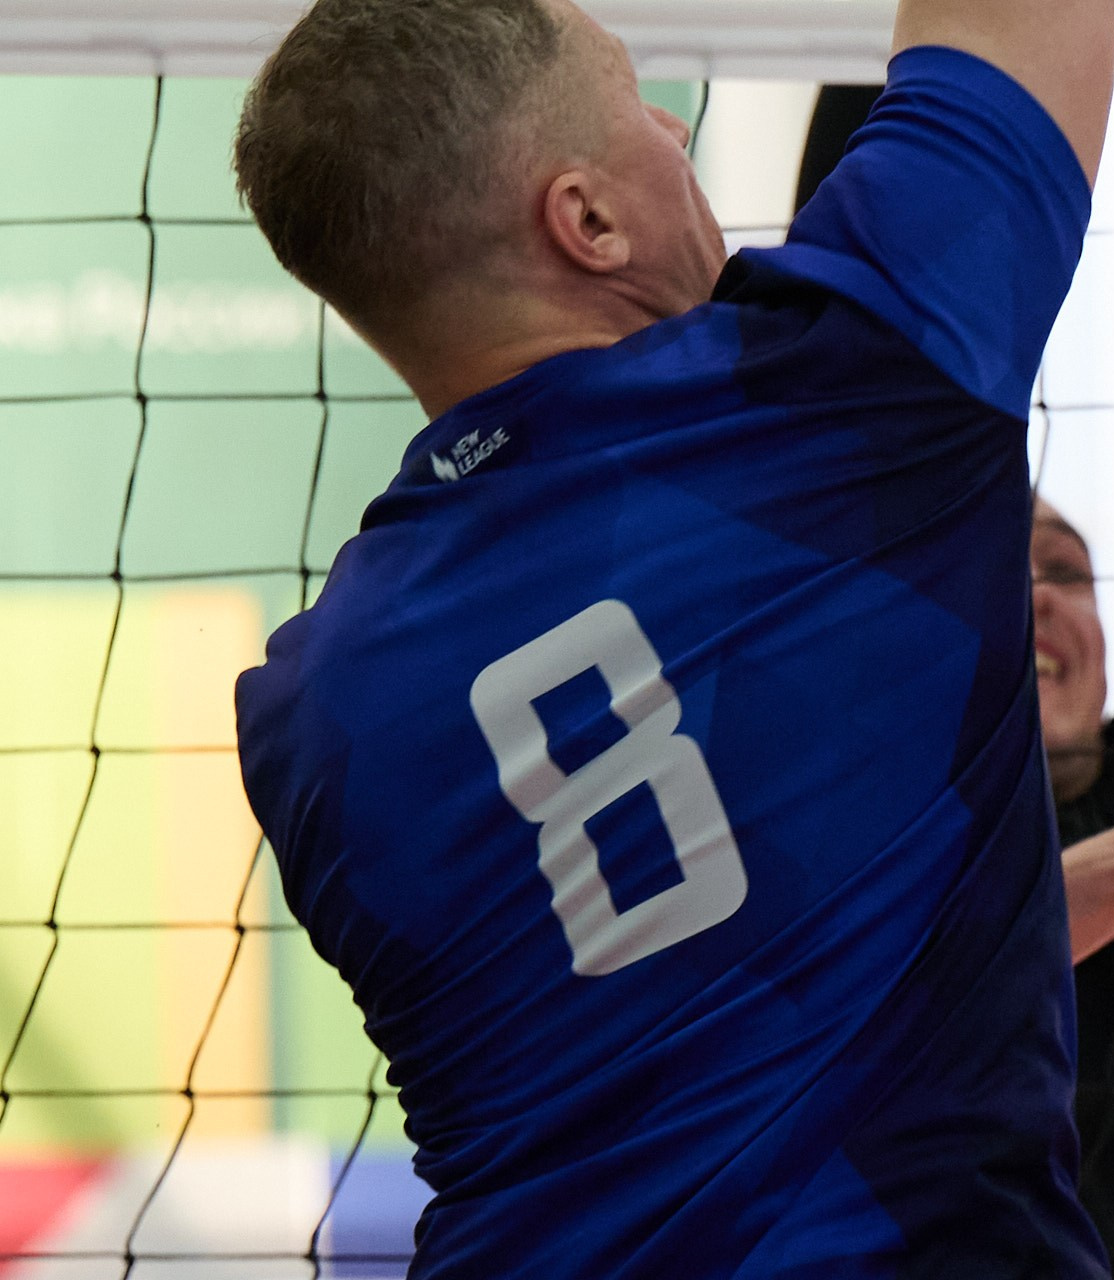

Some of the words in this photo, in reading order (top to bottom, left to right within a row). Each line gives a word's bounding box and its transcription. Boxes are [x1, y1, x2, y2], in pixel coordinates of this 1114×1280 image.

[451, 428, 480, 460] NEW
[457, 427, 511, 477] LEAGUE
[470, 599, 748, 977] 8
